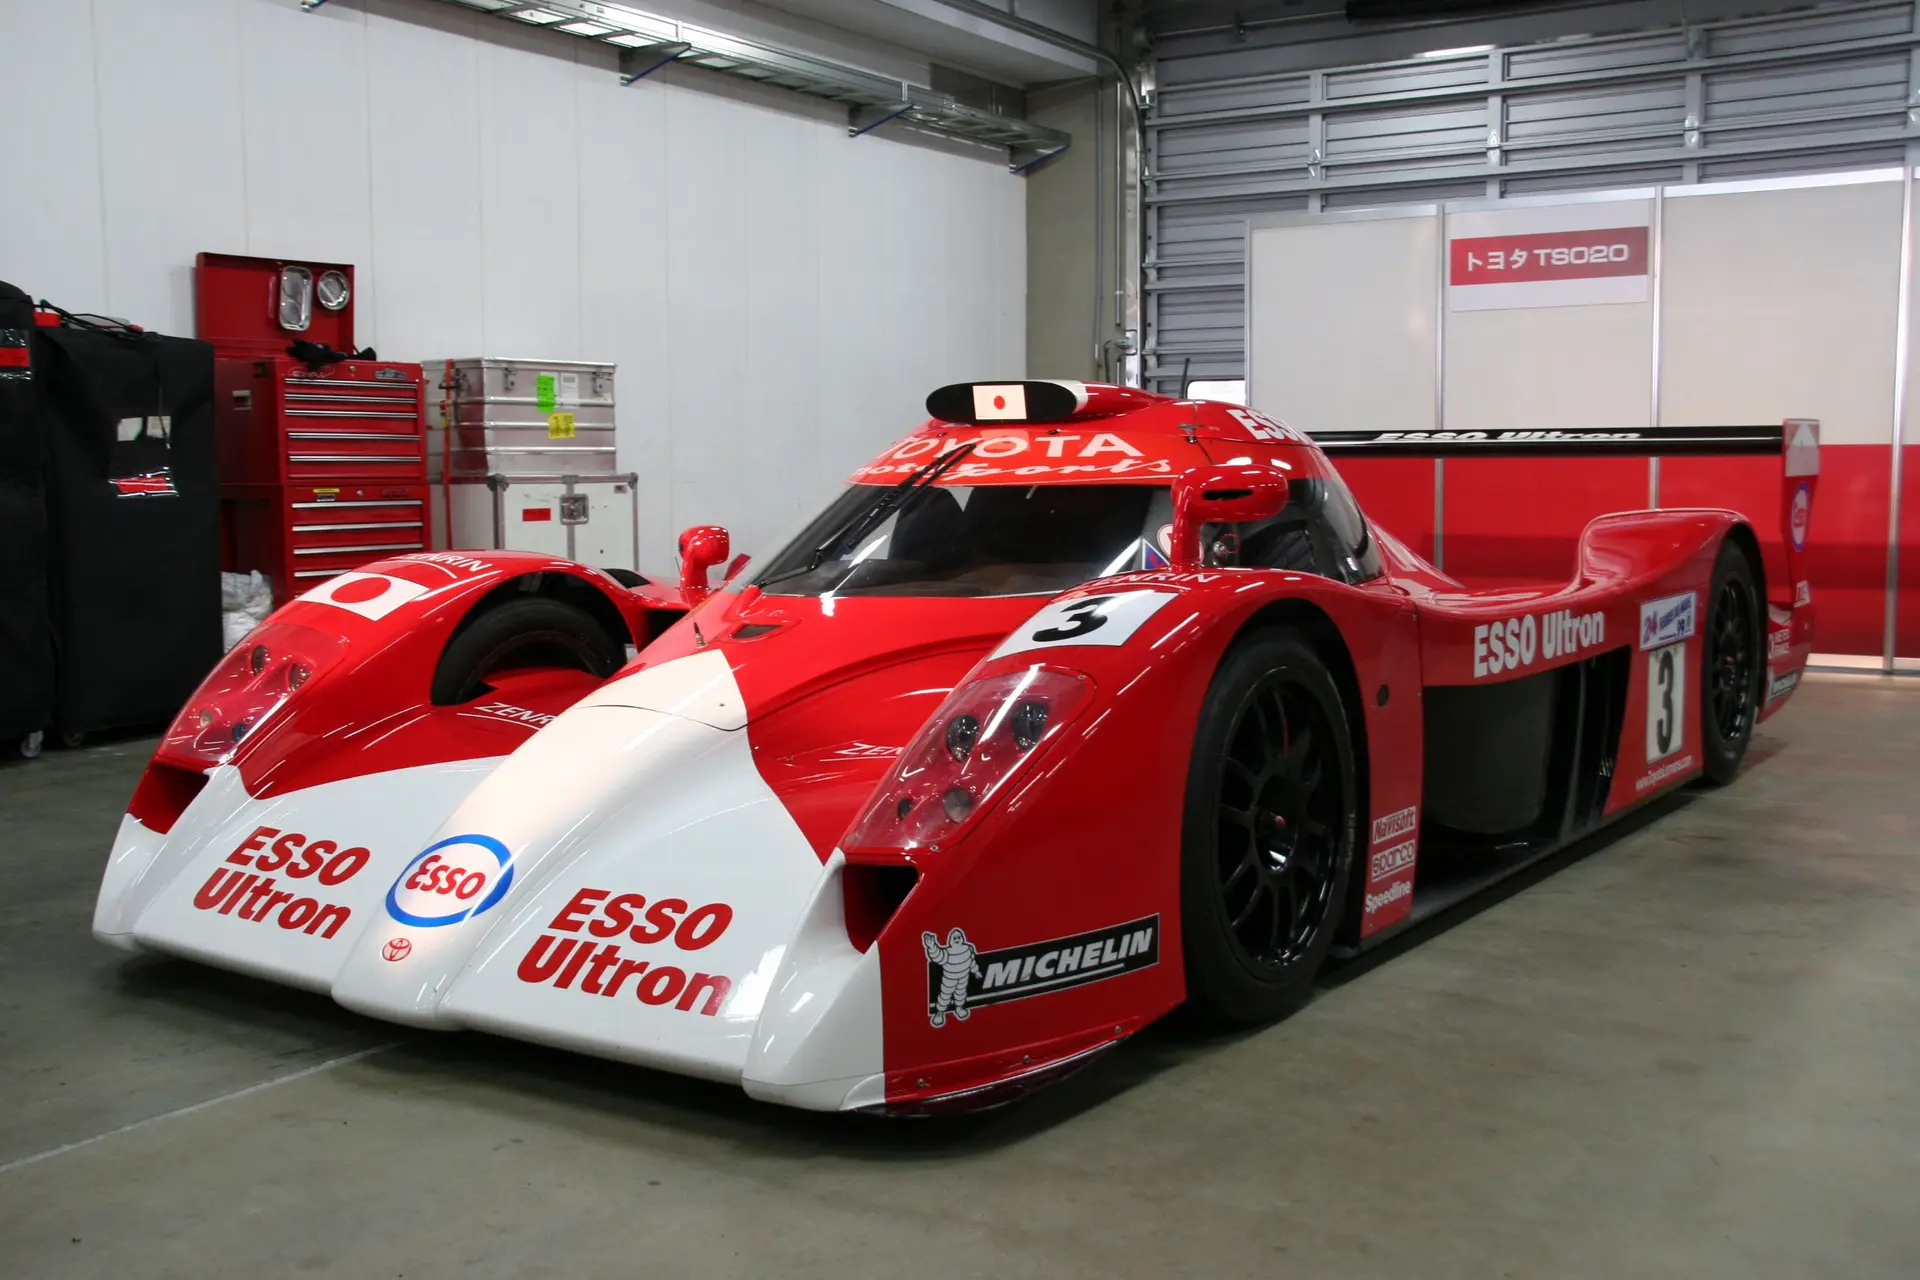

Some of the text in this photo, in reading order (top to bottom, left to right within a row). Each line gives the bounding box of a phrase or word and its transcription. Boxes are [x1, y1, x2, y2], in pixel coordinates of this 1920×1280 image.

[1467, 249, 1528, 272] トヨタ
[876, 433, 1145, 459] TOYOTA
[1373, 431, 1641, 441] ESSO Ultron
[1031, 596, 1109, 642] 3
[1474, 614, 1536, 679] ESSO
[1542, 609, 1604, 659] Ultron
[1656, 650, 1674, 754] 3
[225, 825, 371, 886] ESSO
[1372, 841, 1414, 876] sparco
[193, 867, 352, 939] Ultron
[548, 887, 734, 951] ESSO
[1365, 881, 1411, 914] Speedline
[517, 934, 733, 1017] Ultron
[982, 927, 1153, 990] MICHELIN
